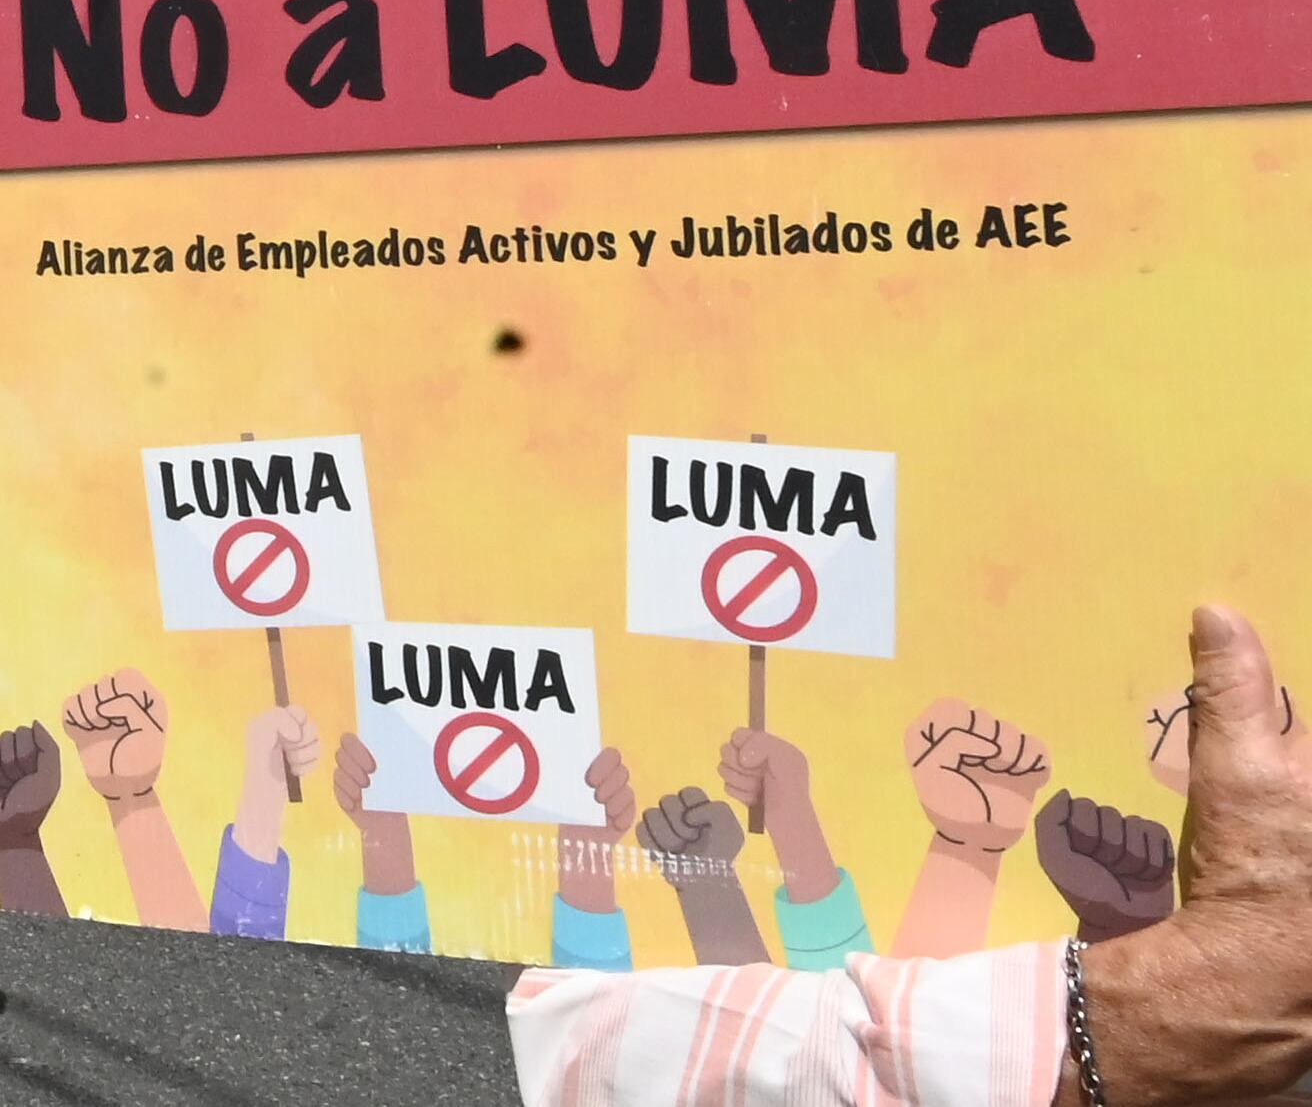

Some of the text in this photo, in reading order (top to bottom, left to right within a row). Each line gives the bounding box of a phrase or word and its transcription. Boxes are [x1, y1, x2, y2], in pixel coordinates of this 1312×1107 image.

[36, 202, 1071, 279] Alianza de Empleados Activos y Jubilados de AEE
[160, 453, 350, 520] LUMA
[652, 457, 876, 540] LUMA
[369, 642, 574, 713] LUMA
